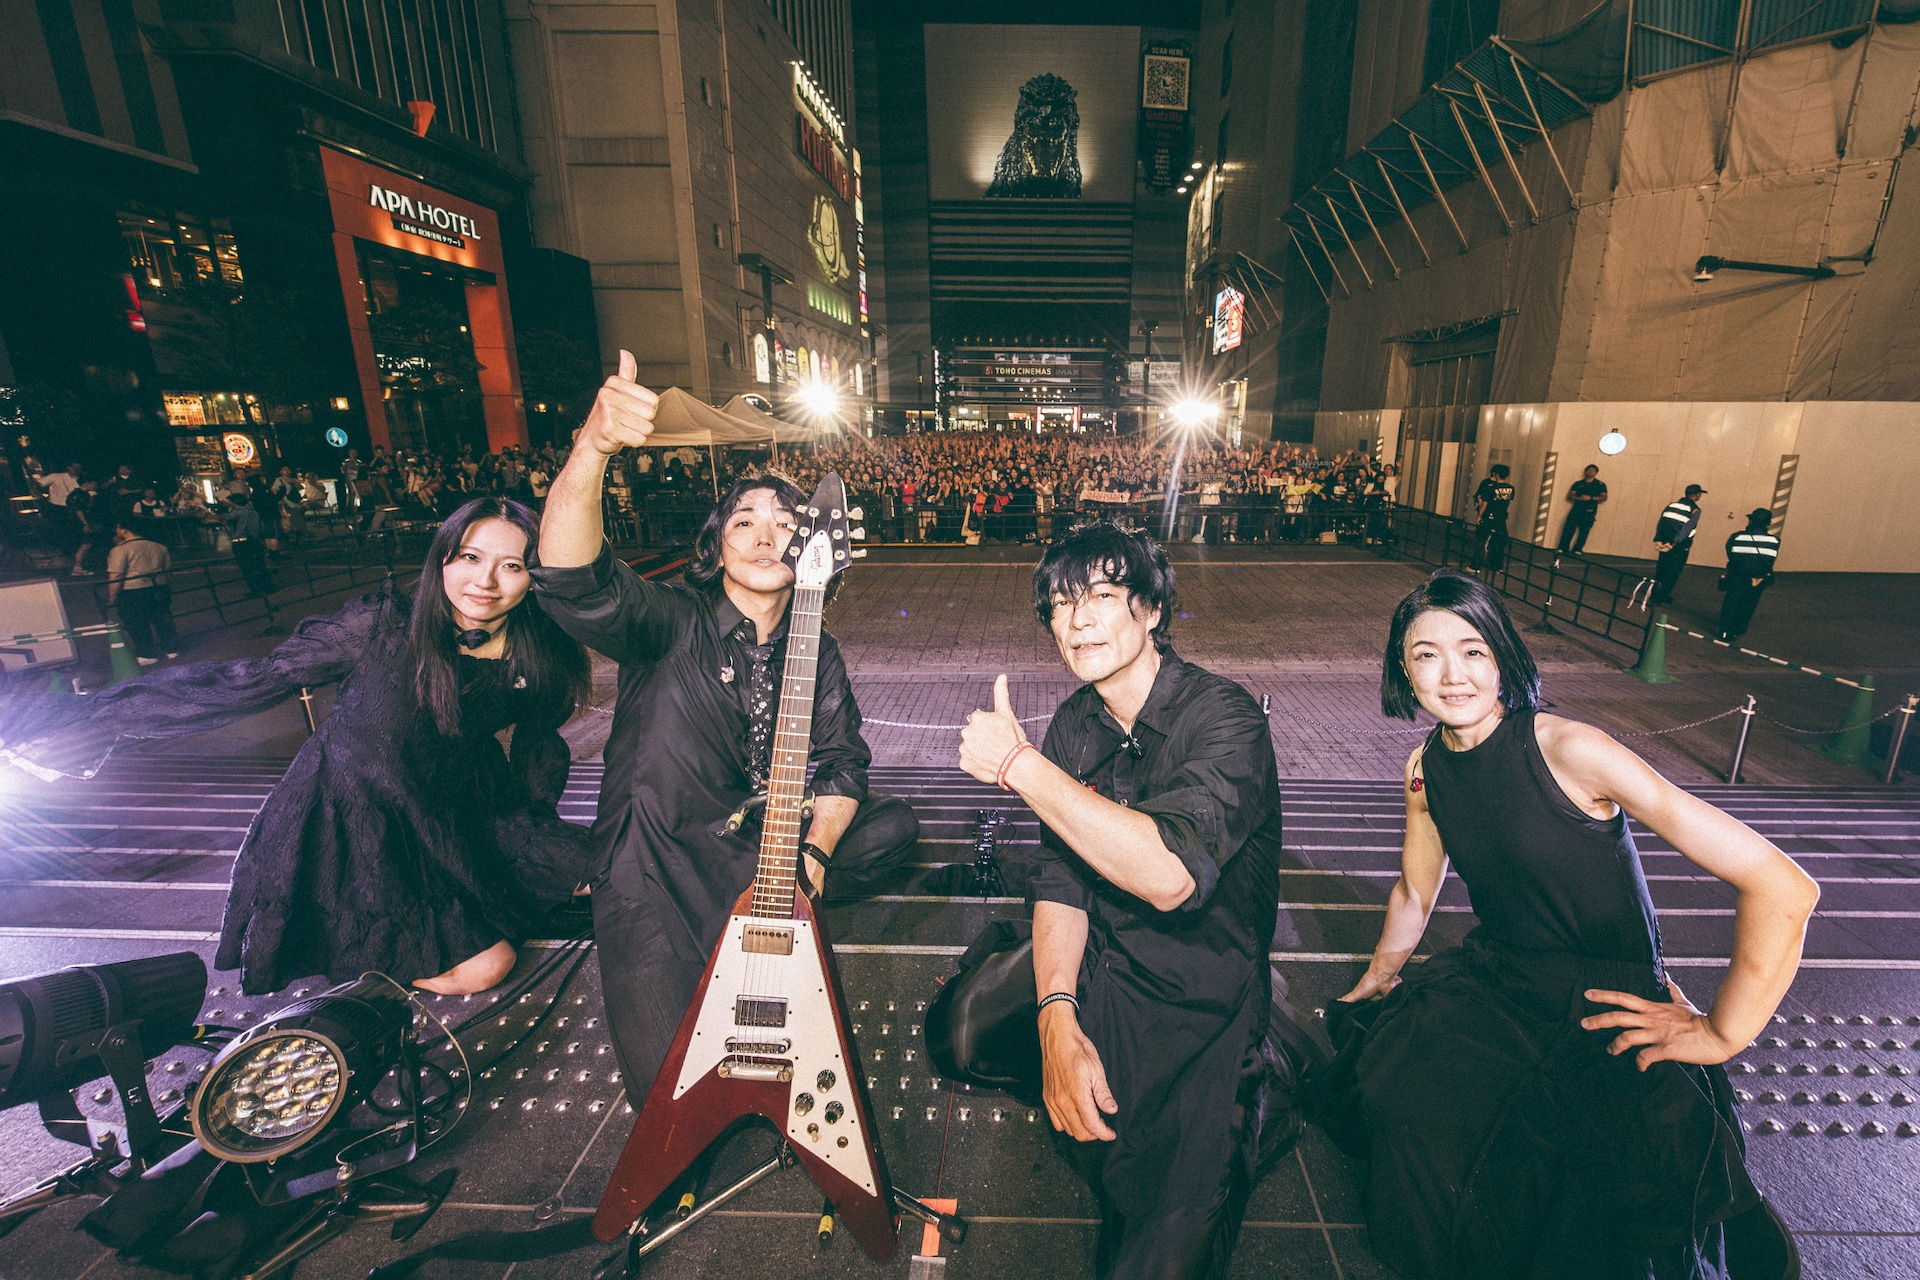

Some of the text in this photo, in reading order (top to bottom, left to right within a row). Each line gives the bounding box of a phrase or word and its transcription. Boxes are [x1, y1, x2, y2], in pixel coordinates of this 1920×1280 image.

[1151, 46, 1184, 56] SCAN HERE
[370, 184, 481, 240] APA HOTEL
[994, 367, 1016, 375] TOHO
[1017, 367, 1052, 376] CINEMAS
